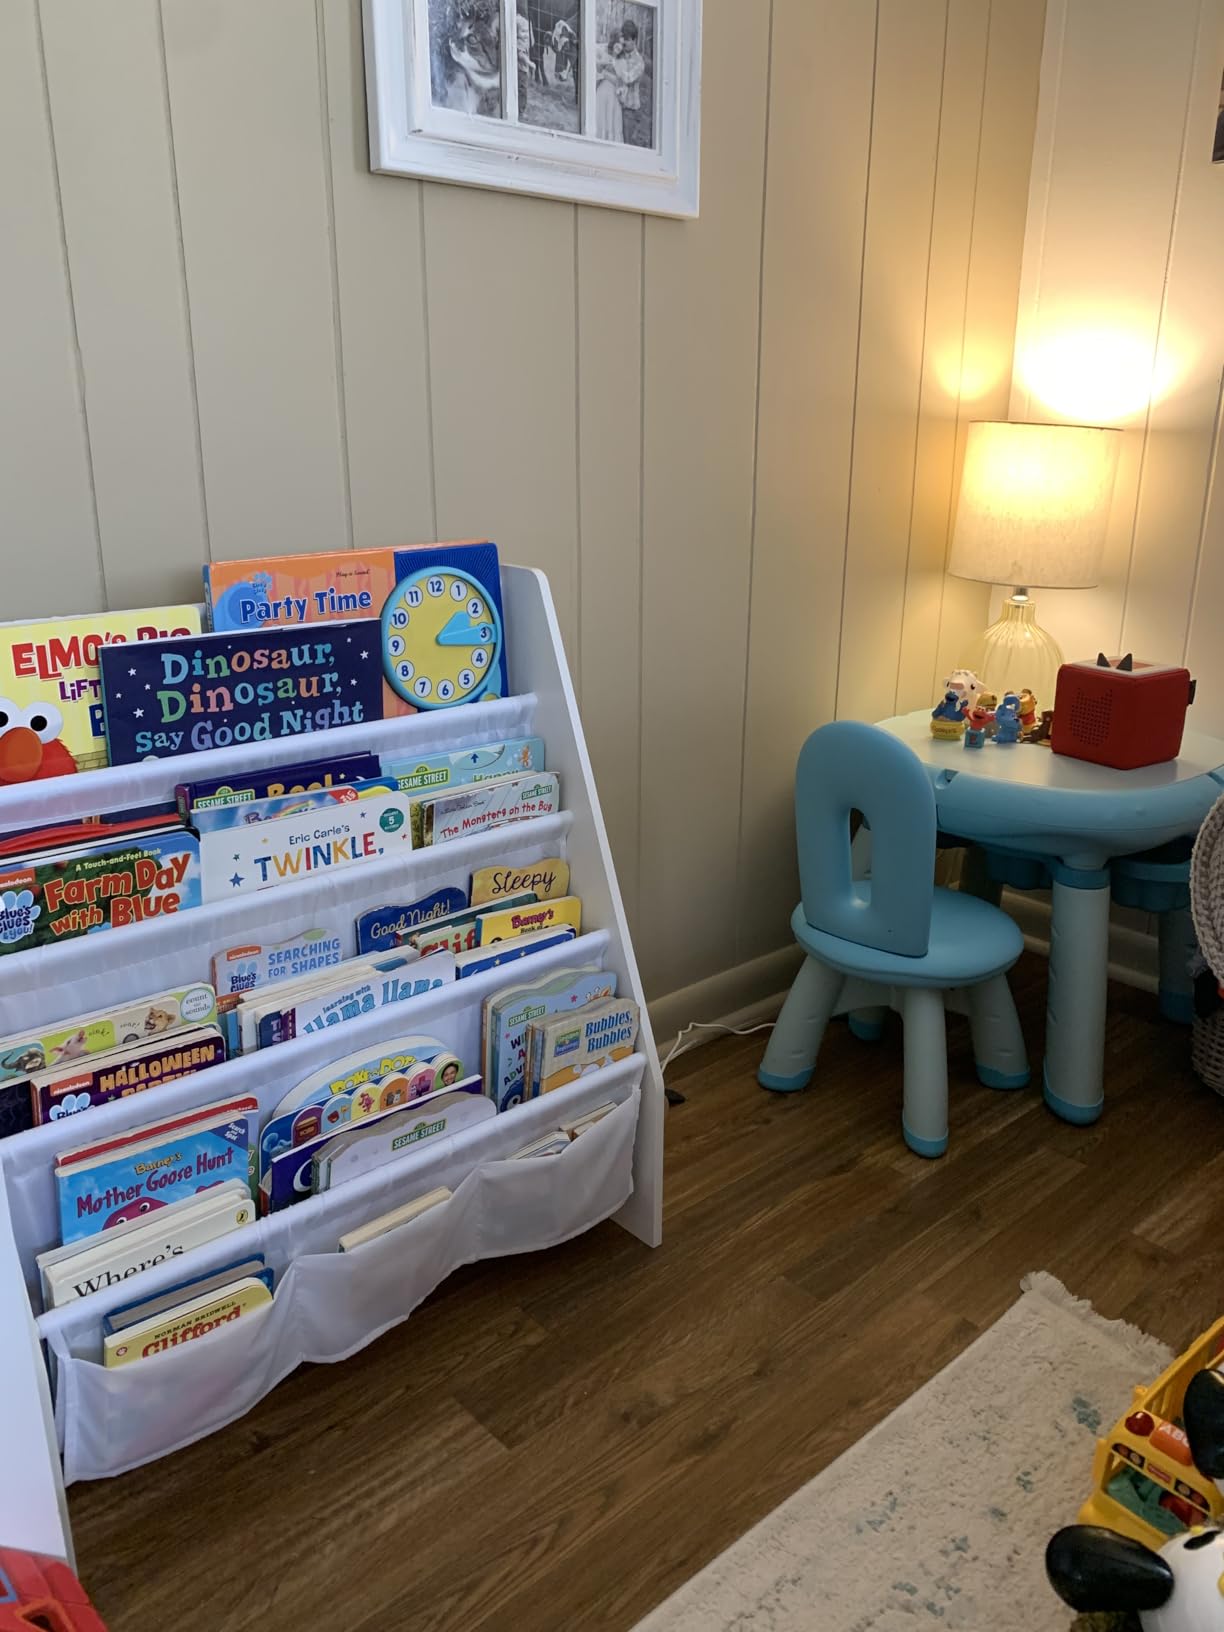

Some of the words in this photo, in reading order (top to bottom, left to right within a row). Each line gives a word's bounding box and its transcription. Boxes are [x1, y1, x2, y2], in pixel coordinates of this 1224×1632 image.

[408, 591, 420, 603] 11
[430, 580, 443, 593] 12
[455, 585, 461, 596] 1
[240, 595, 307, 623] Party
[315, 587, 372, 615] Time
[472, 603, 479, 614] 2
[393, 614, 407, 626] 10
[480, 627, 488, 639] 3
[392, 641, 400, 652] 9
[475, 653, 483, 664] 4
[160, 643, 336, 685] Dinosaur,
[401, 665, 409, 677] 8
[419, 682, 427, 693] 7
[441, 684, 449, 696] 6
[463, 674, 470, 685] 5
[156, 672, 342, 724] Dinosaur,
[191, 711, 272, 752] Good
[279, 699, 364, 736] Night
[423, 770, 448, 785] STREET
[388, 815, 395, 825] 5
[440, 825, 459, 839] The
[462, 806, 507, 831] Monsters
[509, 806, 520, 815] on
[522, 802, 535, 813] the
[289, 833, 311, 846] Eric
[313, 825, 350, 840] Carle's
[75, 863, 81, 872] A
[84, 852, 142, 870] Touch-and-Feel
[143, 848, 162, 859] Book
[254, 832, 384, 882] TWINKLE,
[44, 871, 133, 914] Farm
[135, 851, 191, 892] Day
[492, 869, 556, 894] Sleepy
[50, 905, 103, 936] with
[111, 892, 181, 929] Blue
[371, 915, 406, 939] Good
[408, 899, 451, 926] Night!
[511, 908, 554, 930] Barney's
[268, 938, 341, 966] SEARCHING
[268, 967, 286, 979] FOR
[291, 952, 339, 975] SHAPES
[231, 972, 257, 985] Blue's
[322, 991, 354, 1013] learning
[355, 984, 371, 997] with
[509, 1011, 528, 1026] SESAME
[528, 1006, 545, 1019] STREET
[585, 1010, 633, 1038] Bubbles,
[587, 1026, 632, 1054] Bubbles
[100, 1045, 216, 1093] HALLOWEEN
[224, 1131, 238, 1141] Spot
[228, 1122, 246, 1135] Search
[393, 1132, 420, 1149] SESAME
[420, 1120, 445, 1138] STREET
[134, 1152, 183, 1177] Barney's
[77, 1182, 144, 1218] Mother
[146, 1167, 193, 1192] Goose
[196, 1147, 234, 1176] Hunt
[72, 1245, 184, 1298] Where's
[142, 1305, 241, 1359] Clifford
[154, 1320, 193, 1339] NORMAN
[195, 1301, 237, 1322] BRIDWELL
